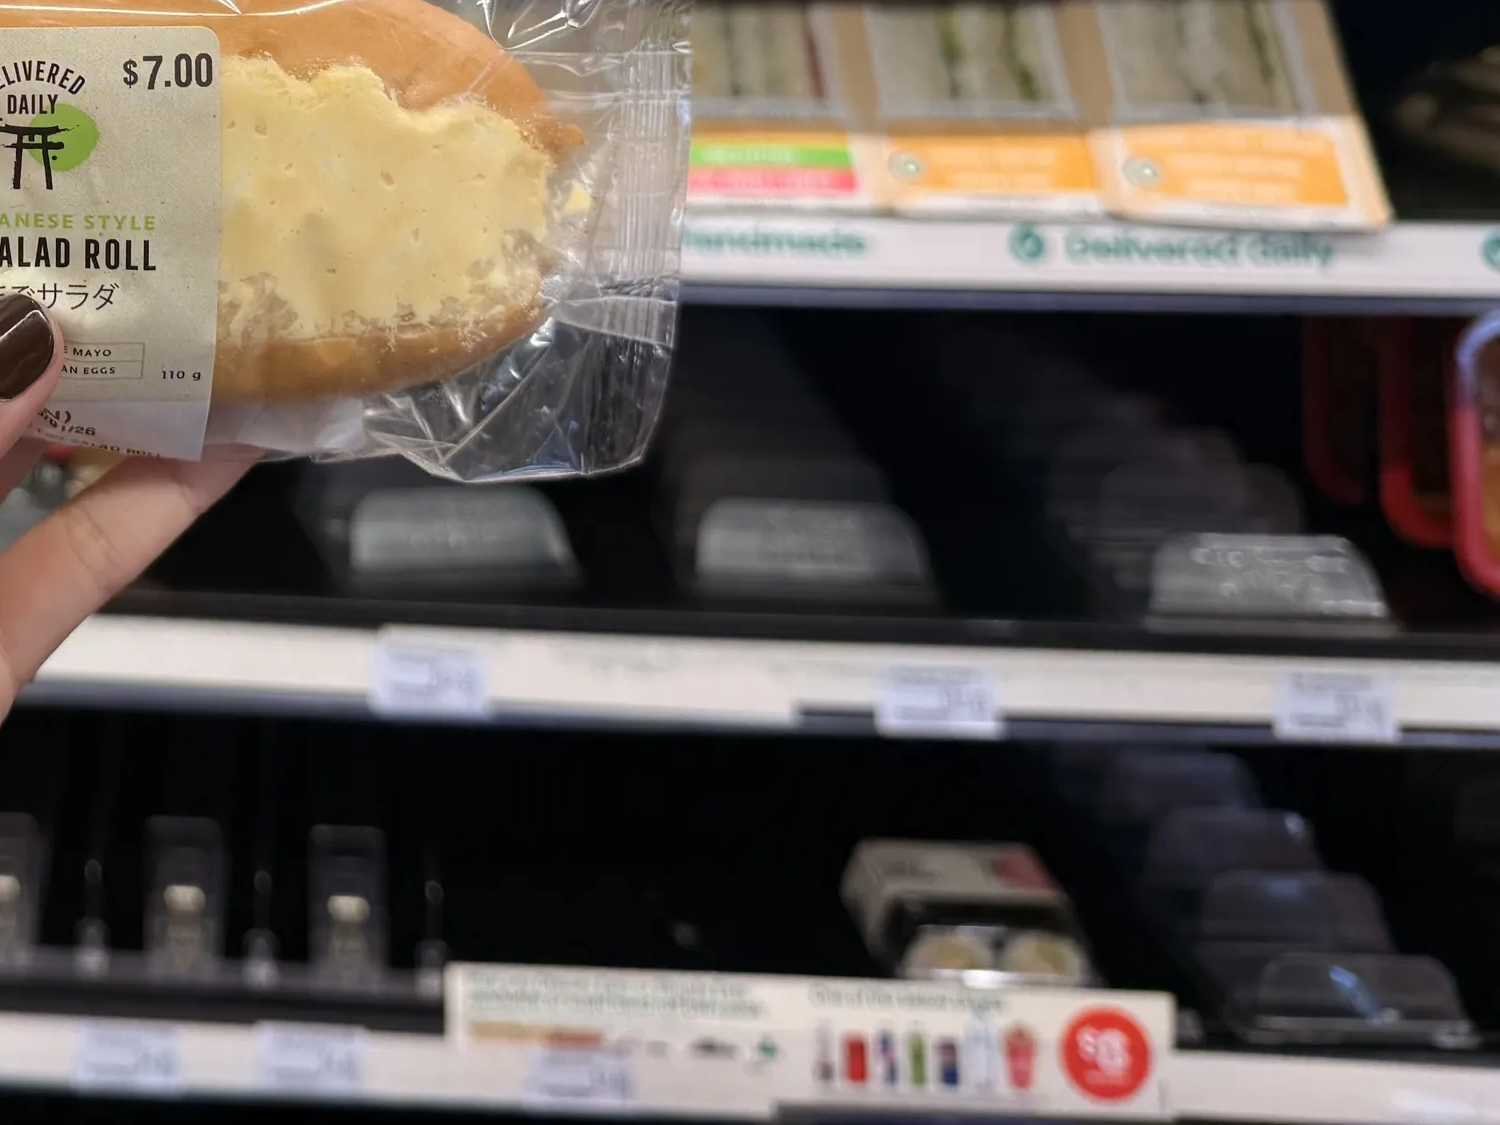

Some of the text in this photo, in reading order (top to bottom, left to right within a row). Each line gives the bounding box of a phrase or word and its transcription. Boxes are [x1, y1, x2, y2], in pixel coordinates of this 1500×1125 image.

[123, 53, 213, 90] $7.00
[7, 94, 58, 115] DAILY
[84, 214, 156, 231] STYLE
[85, 239, 157, 271] ROLL
[1065, 233, 1240, 263] Delivered
[73, 348, 112, 357] MAYO
[83, 367, 116, 375] EGGS
[161, 370, 201, 381] 110 g
